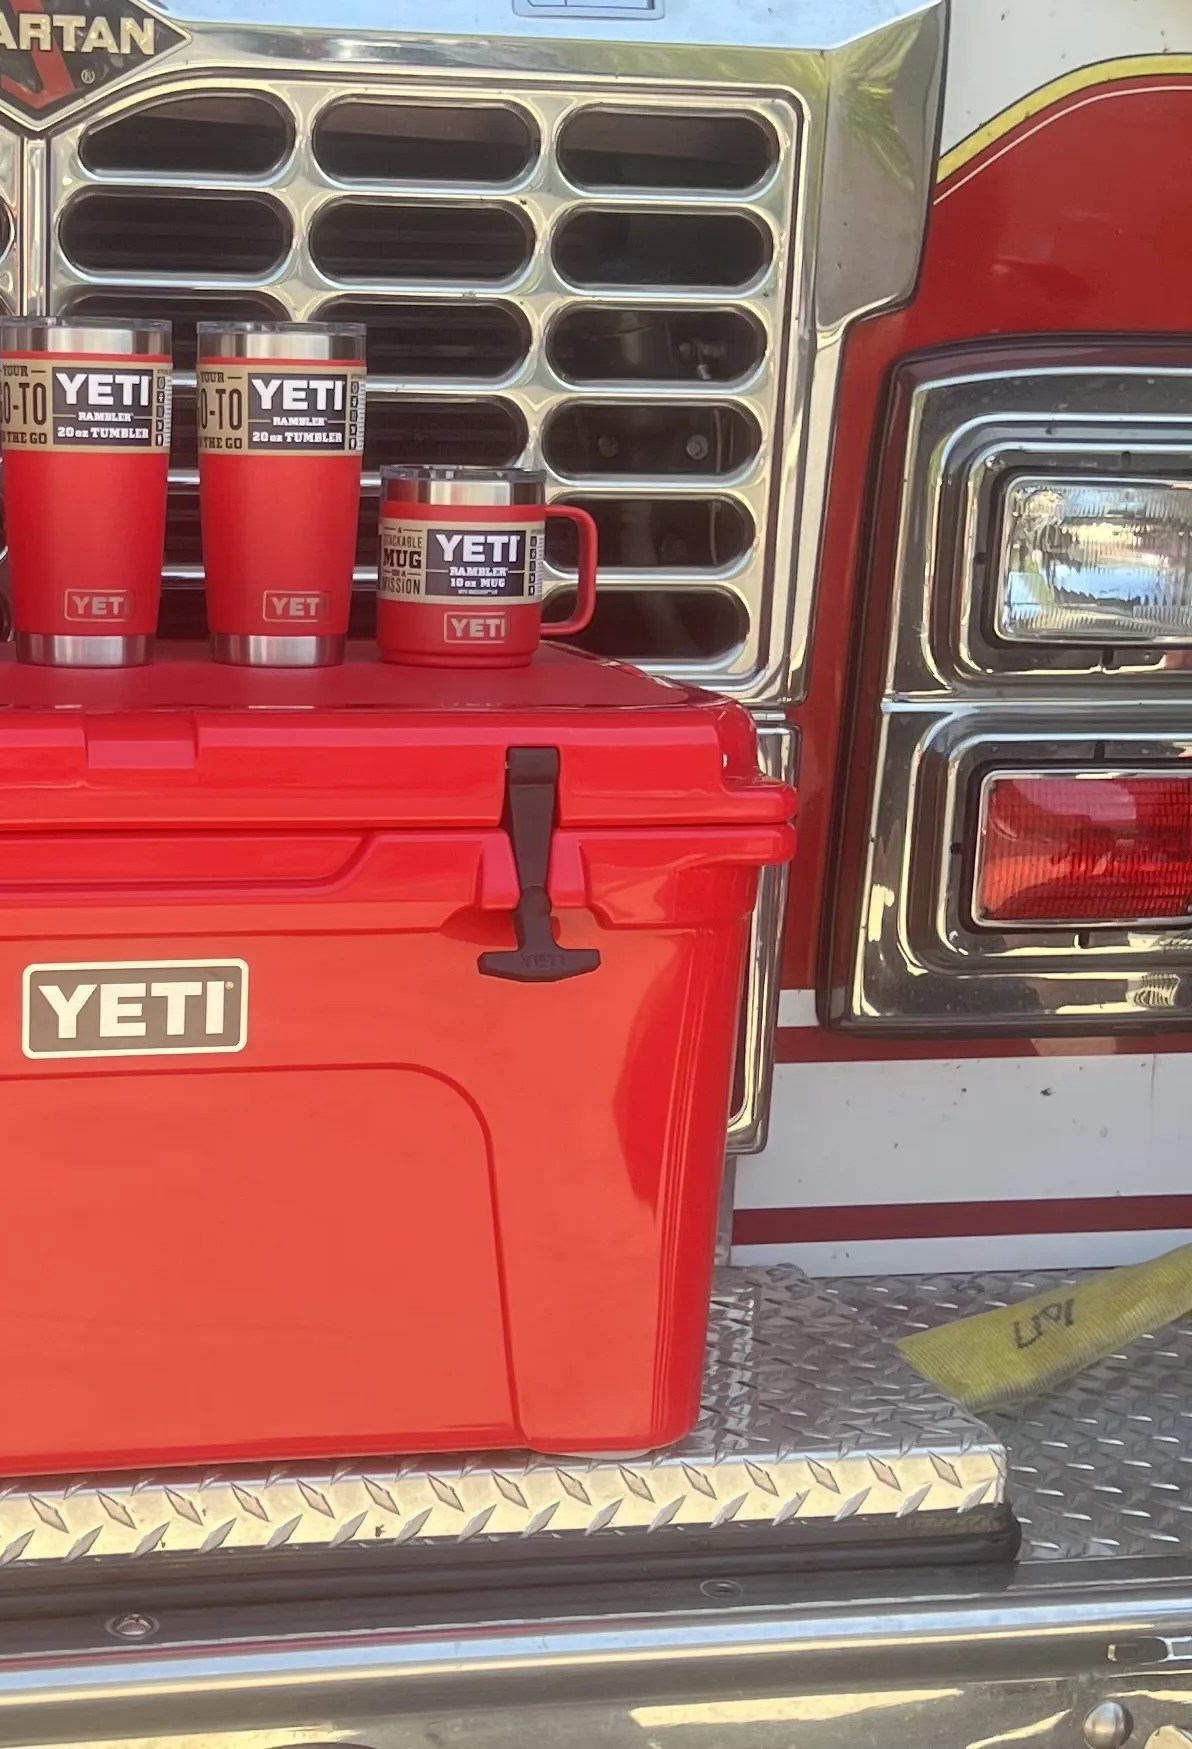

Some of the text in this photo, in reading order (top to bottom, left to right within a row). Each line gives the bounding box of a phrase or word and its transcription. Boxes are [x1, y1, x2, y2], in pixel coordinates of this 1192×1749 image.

[3, 365, 28, 377] YOUR
[56, 373, 149, 406] YETI
[252, 379, 343, 411] YETI
[78, 412, 133, 422] RAMBLER
[272, 417, 326, 427] RAMBLER
[30, 432, 47, 445] GO
[57, 427, 149, 439] 20oz TUMBLER
[252, 432, 342, 443] 20oz TUMBLER
[225, 437, 242, 449] GO
[436, 534, 518, 562] YETI
[383, 548, 422, 569] MUG
[449, 566, 507, 577] RAMBLER
[382, 576, 421, 595] MISSION
[450, 578, 506, 588] 10oz MUG
[71, 595, 132, 615] YETI
[451, 618, 505, 637] YETI
[38, 980, 225, 1039] YETI
